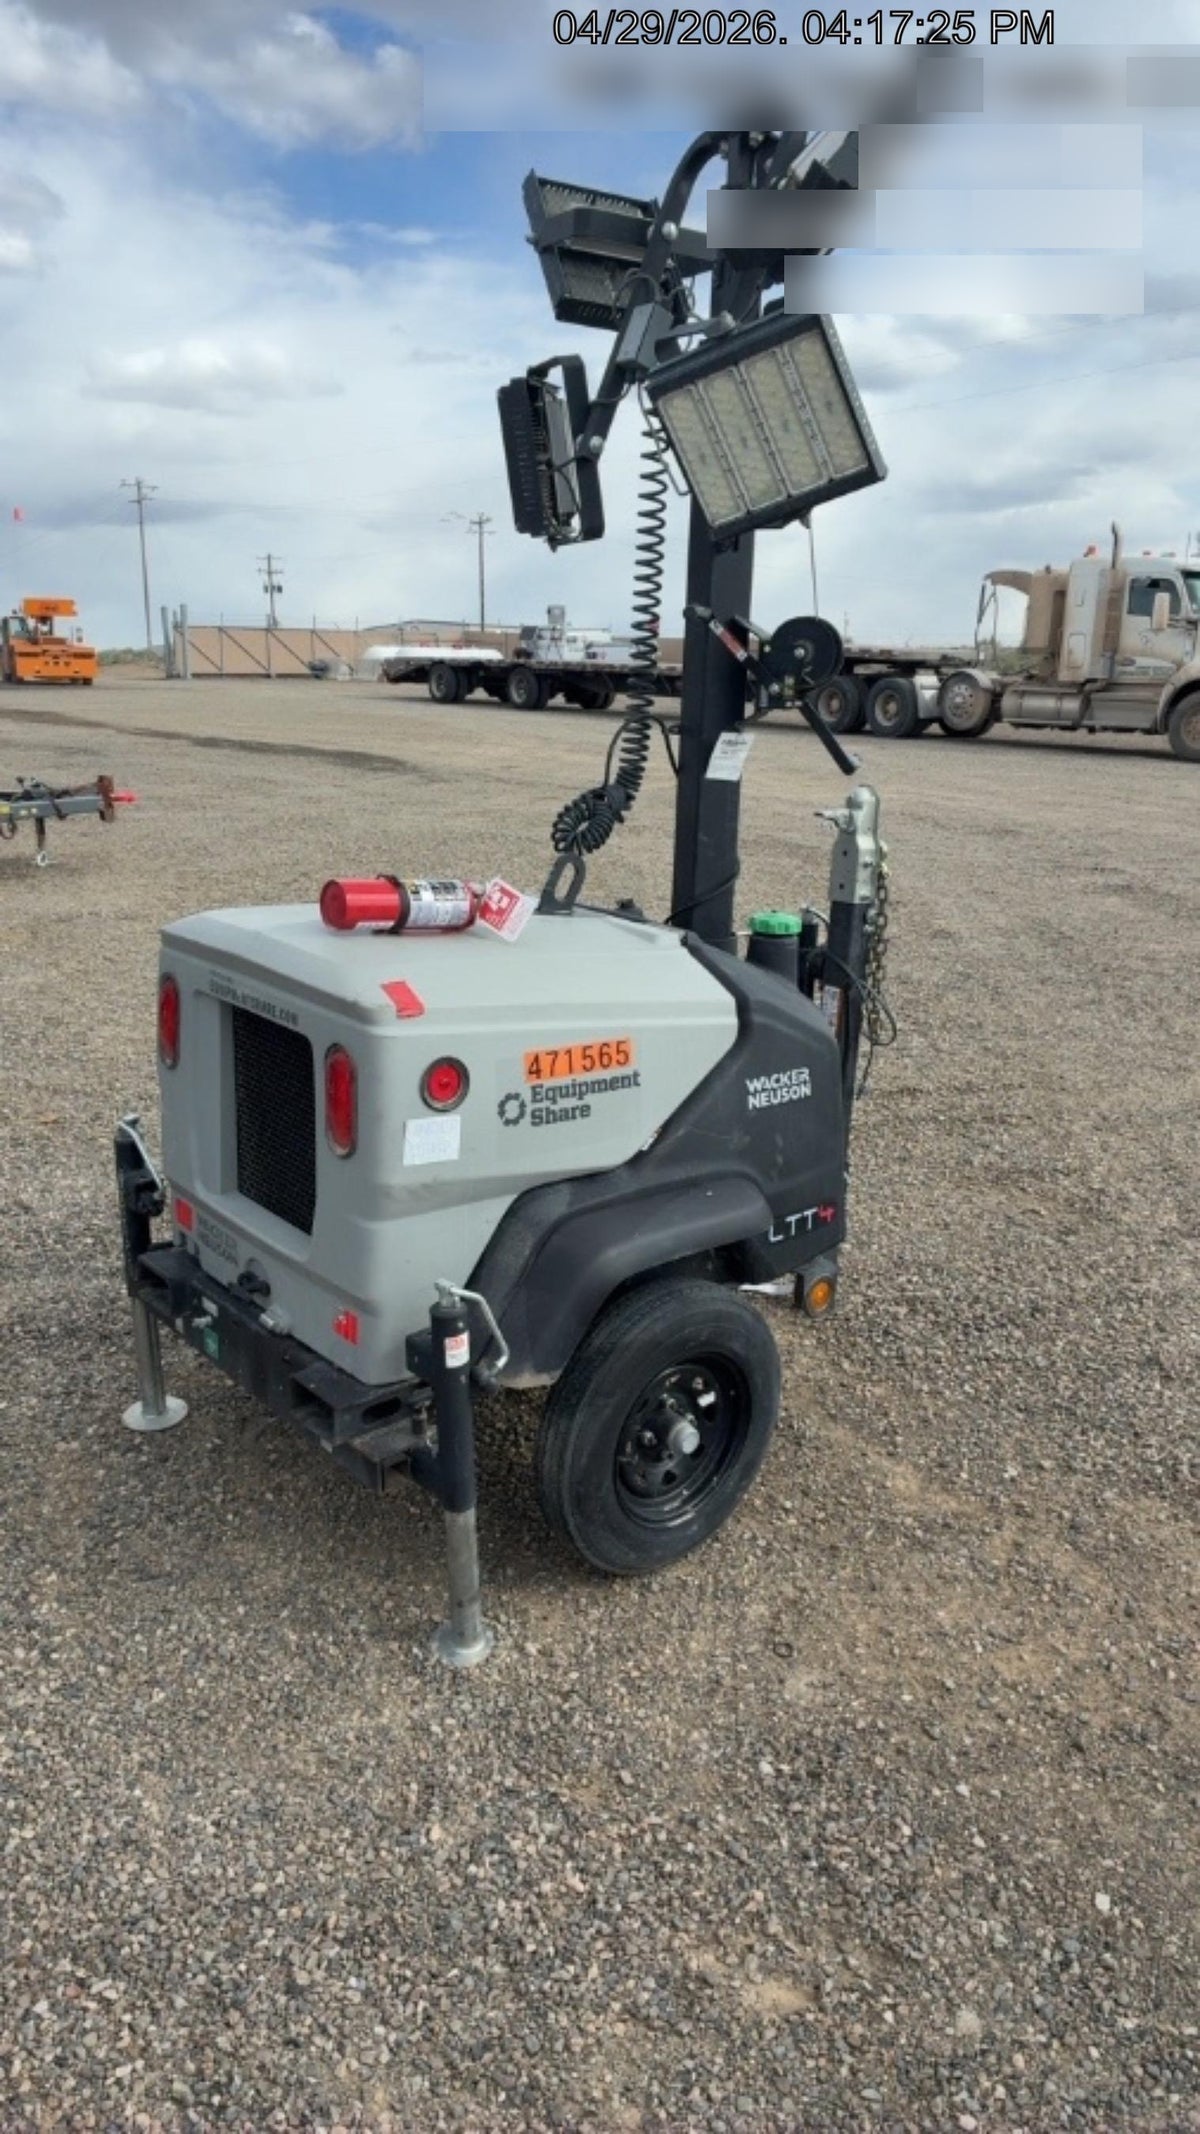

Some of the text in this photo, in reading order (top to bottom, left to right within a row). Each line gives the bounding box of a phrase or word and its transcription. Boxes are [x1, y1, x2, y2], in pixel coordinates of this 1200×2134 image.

[528, 1040, 630, 1079] 471565
[531, 1069, 641, 1104] Equipment
[745, 1067, 810, 1093] WACKER
[748, 1083, 812, 1110] NEUSON
[530, 1103, 591, 1126] Share
[767, 1205, 835, 1243] LTT4
